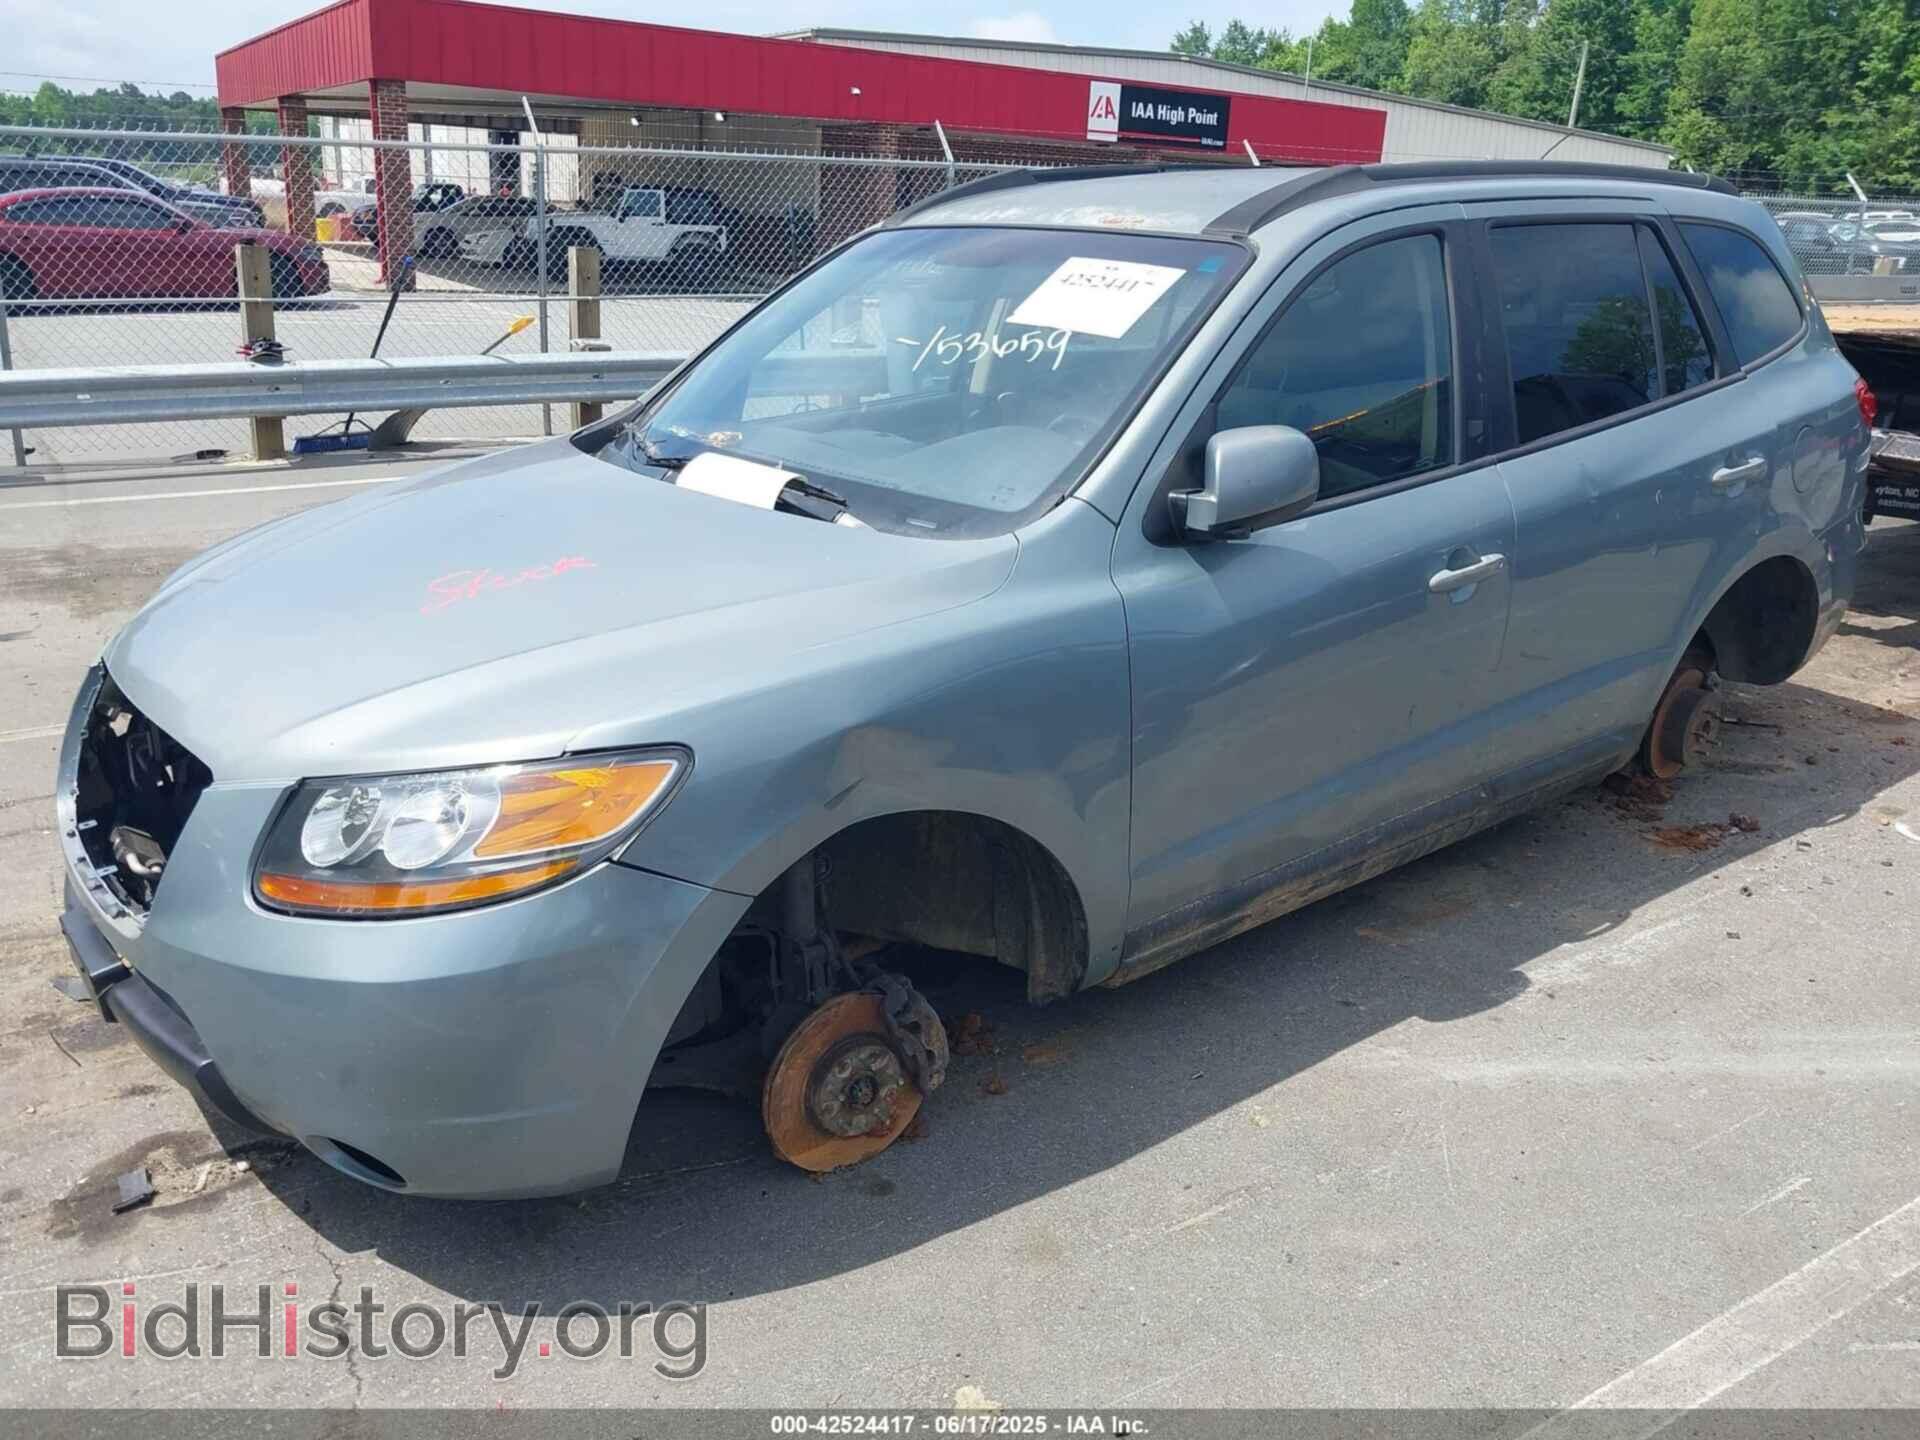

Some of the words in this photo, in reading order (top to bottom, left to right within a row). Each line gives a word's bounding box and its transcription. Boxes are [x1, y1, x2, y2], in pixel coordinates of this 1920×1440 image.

[1131, 101, 1155, 119] IAA
[1157, 104, 1185, 126] High
[1188, 107, 1218, 126] Point
[1905, 487, 1919, 498] NC
